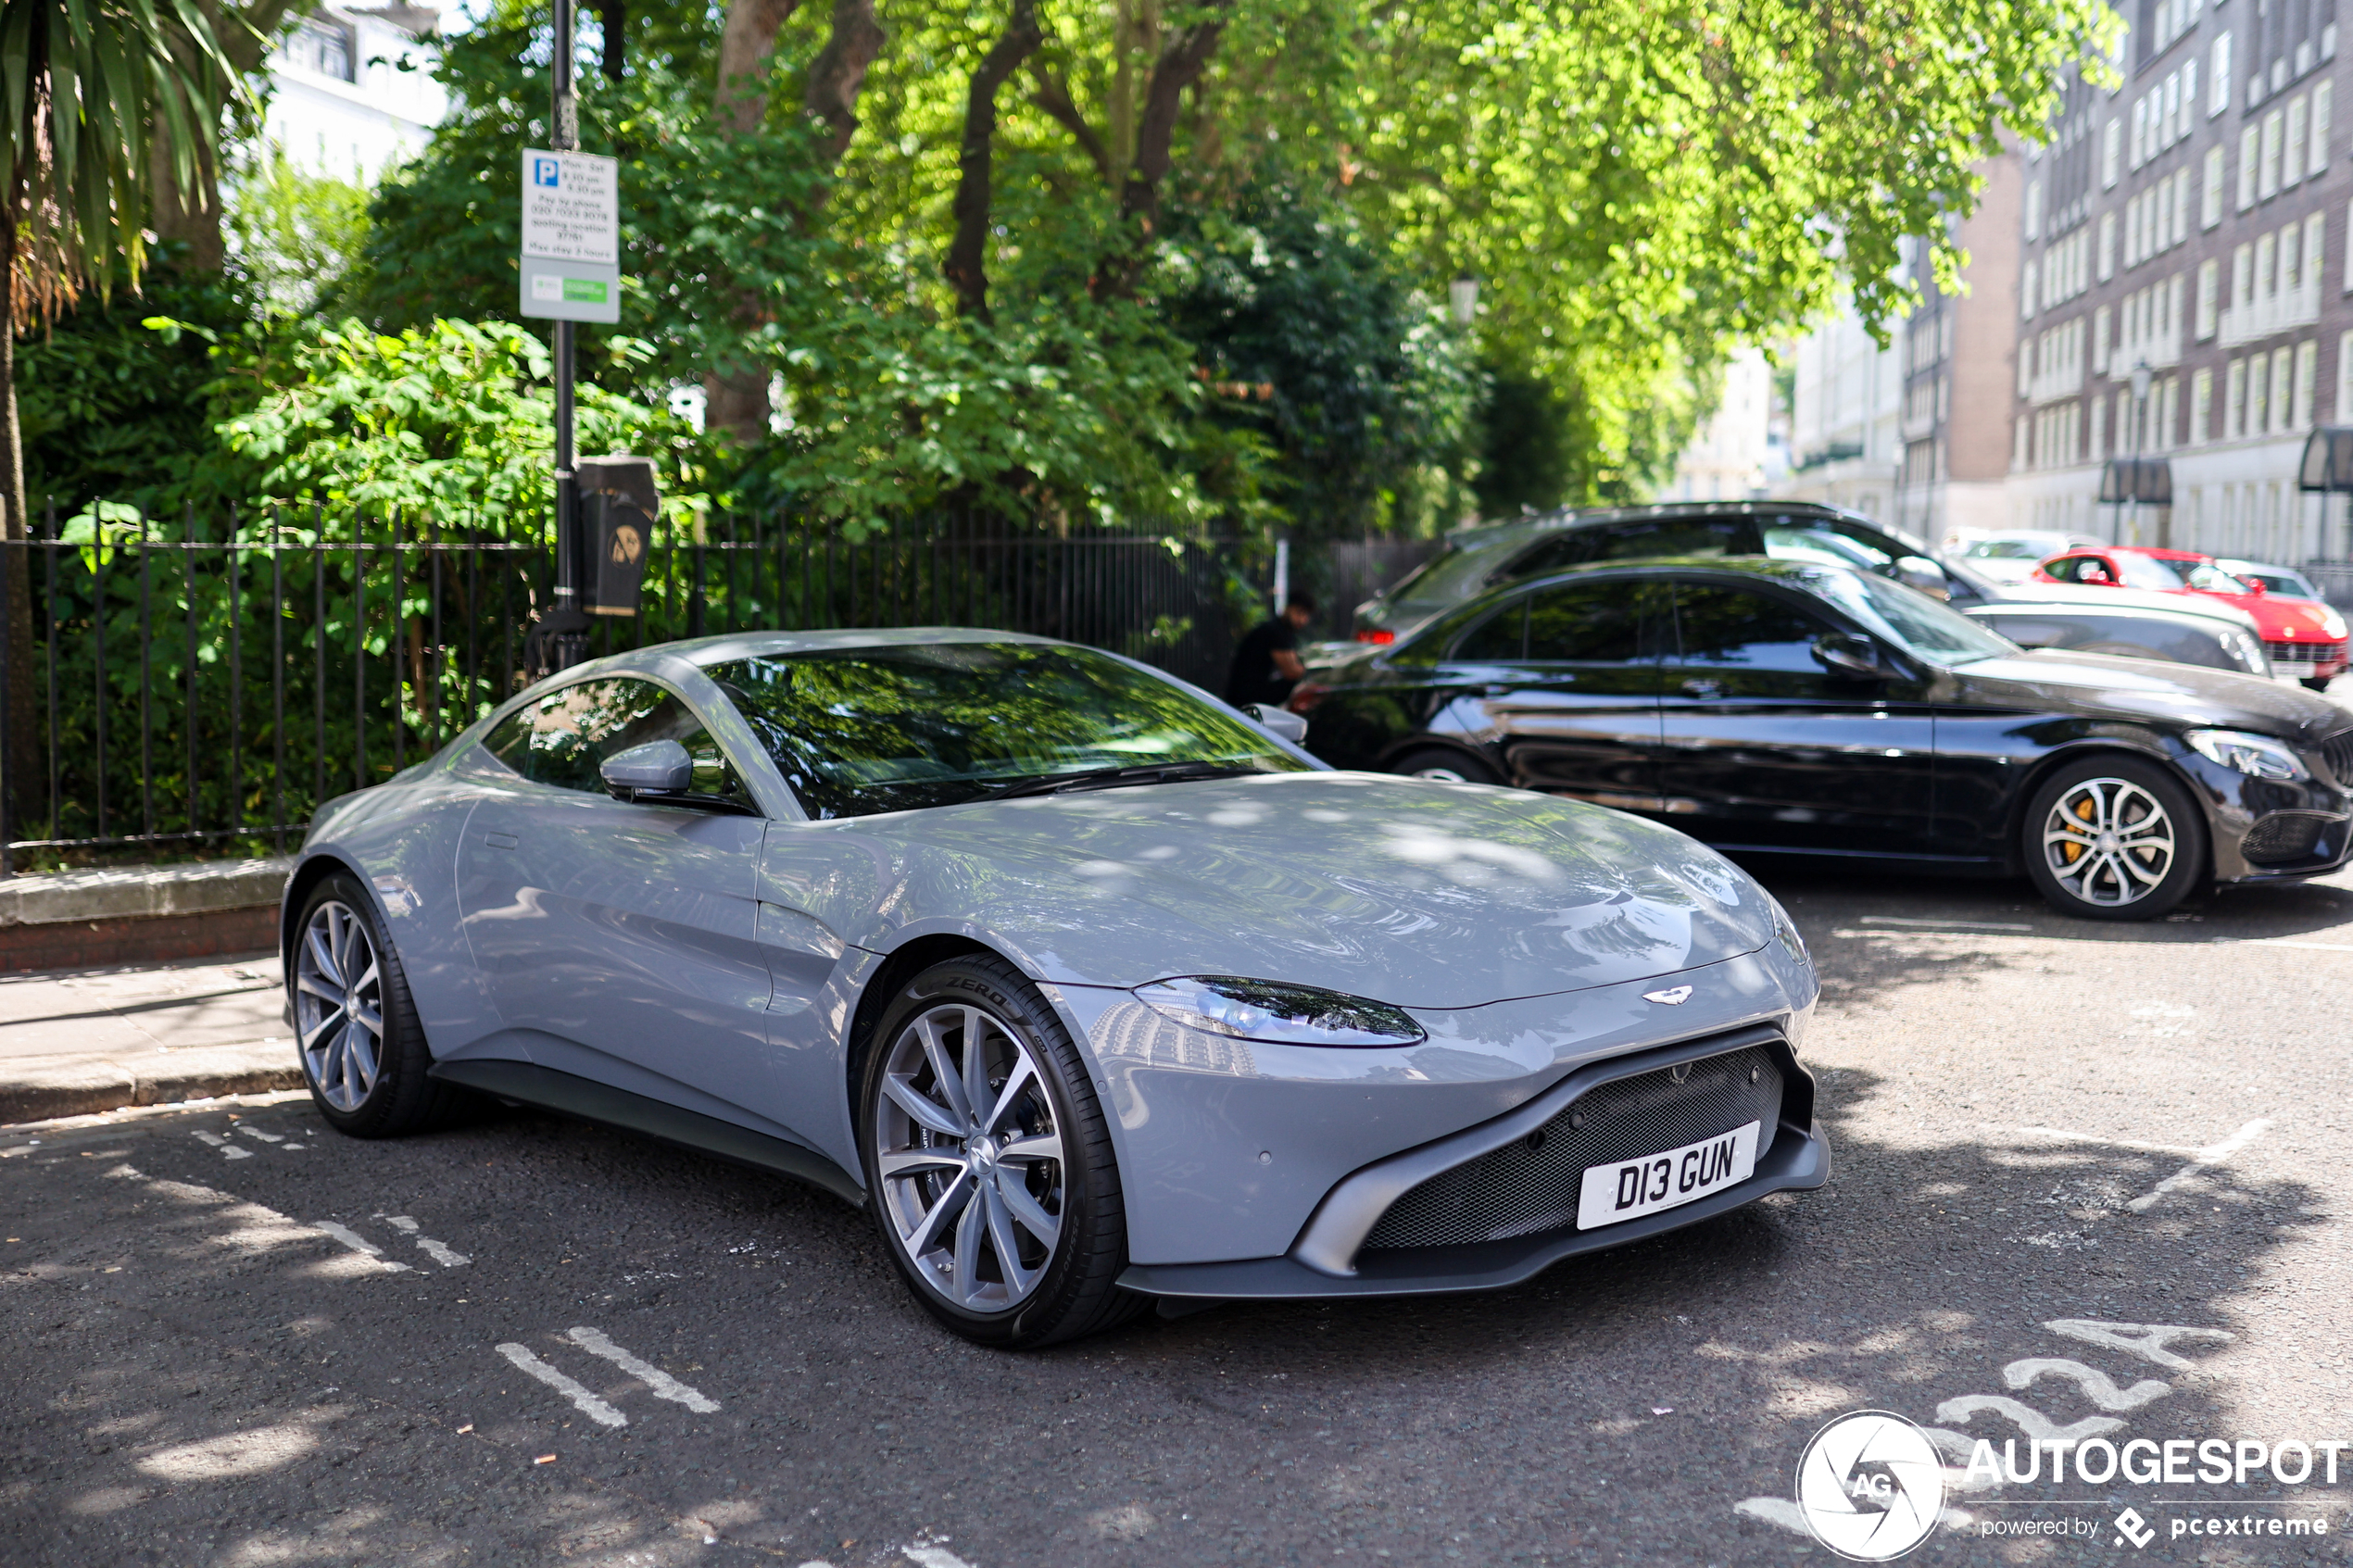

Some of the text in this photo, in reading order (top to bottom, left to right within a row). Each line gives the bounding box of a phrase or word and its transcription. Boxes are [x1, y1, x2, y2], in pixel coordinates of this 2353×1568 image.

[539, 160, 556, 185] P
[538, 194, 601, 211] Pay by phone
[531, 219, 608, 234] quoting location
[529, 241, 548, 253] Max
[552, 245, 571, 257] stay
[584, 246, 610, 258] hours
[946, 976, 1008, 1007] ZERO
[1615, 1135, 1736, 1211] D13 GUN
